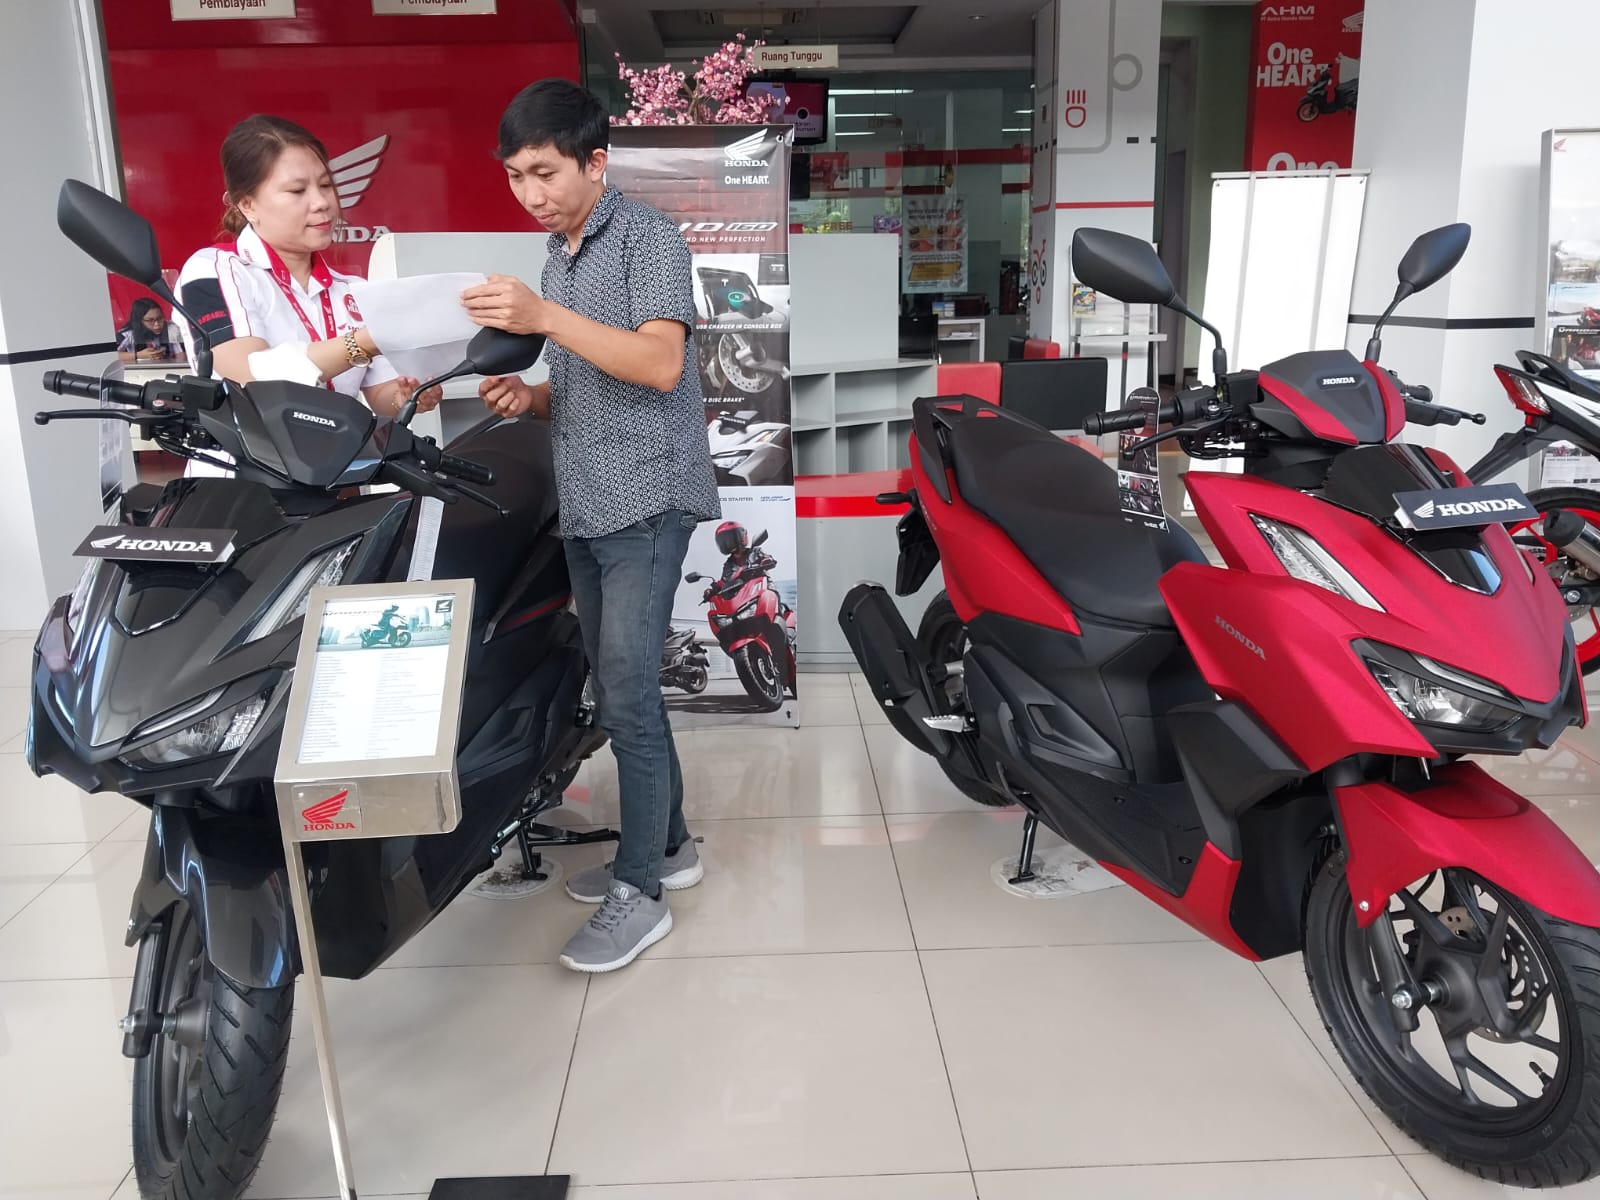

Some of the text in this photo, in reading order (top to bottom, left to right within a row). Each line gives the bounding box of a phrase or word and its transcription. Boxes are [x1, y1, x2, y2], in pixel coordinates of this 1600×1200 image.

[1261, 5, 1315, 15] AHM
[761, 51, 823, 63] Ruang Tunggu
[1267, 42, 1314, 64] One
[724, 159, 769, 167] HONDA
[724, 175, 741, 185] One
[726, 222, 778, 232] 160
[1322, 376, 1356, 385] HONDA
[293, 411, 336, 427] HONDA
[1435, 498, 1527, 517] HONDA
[115, 539, 213, 552] HONDA
[1215, 614, 1266, 661] HONDA
[303, 822, 356, 831] HONDA
